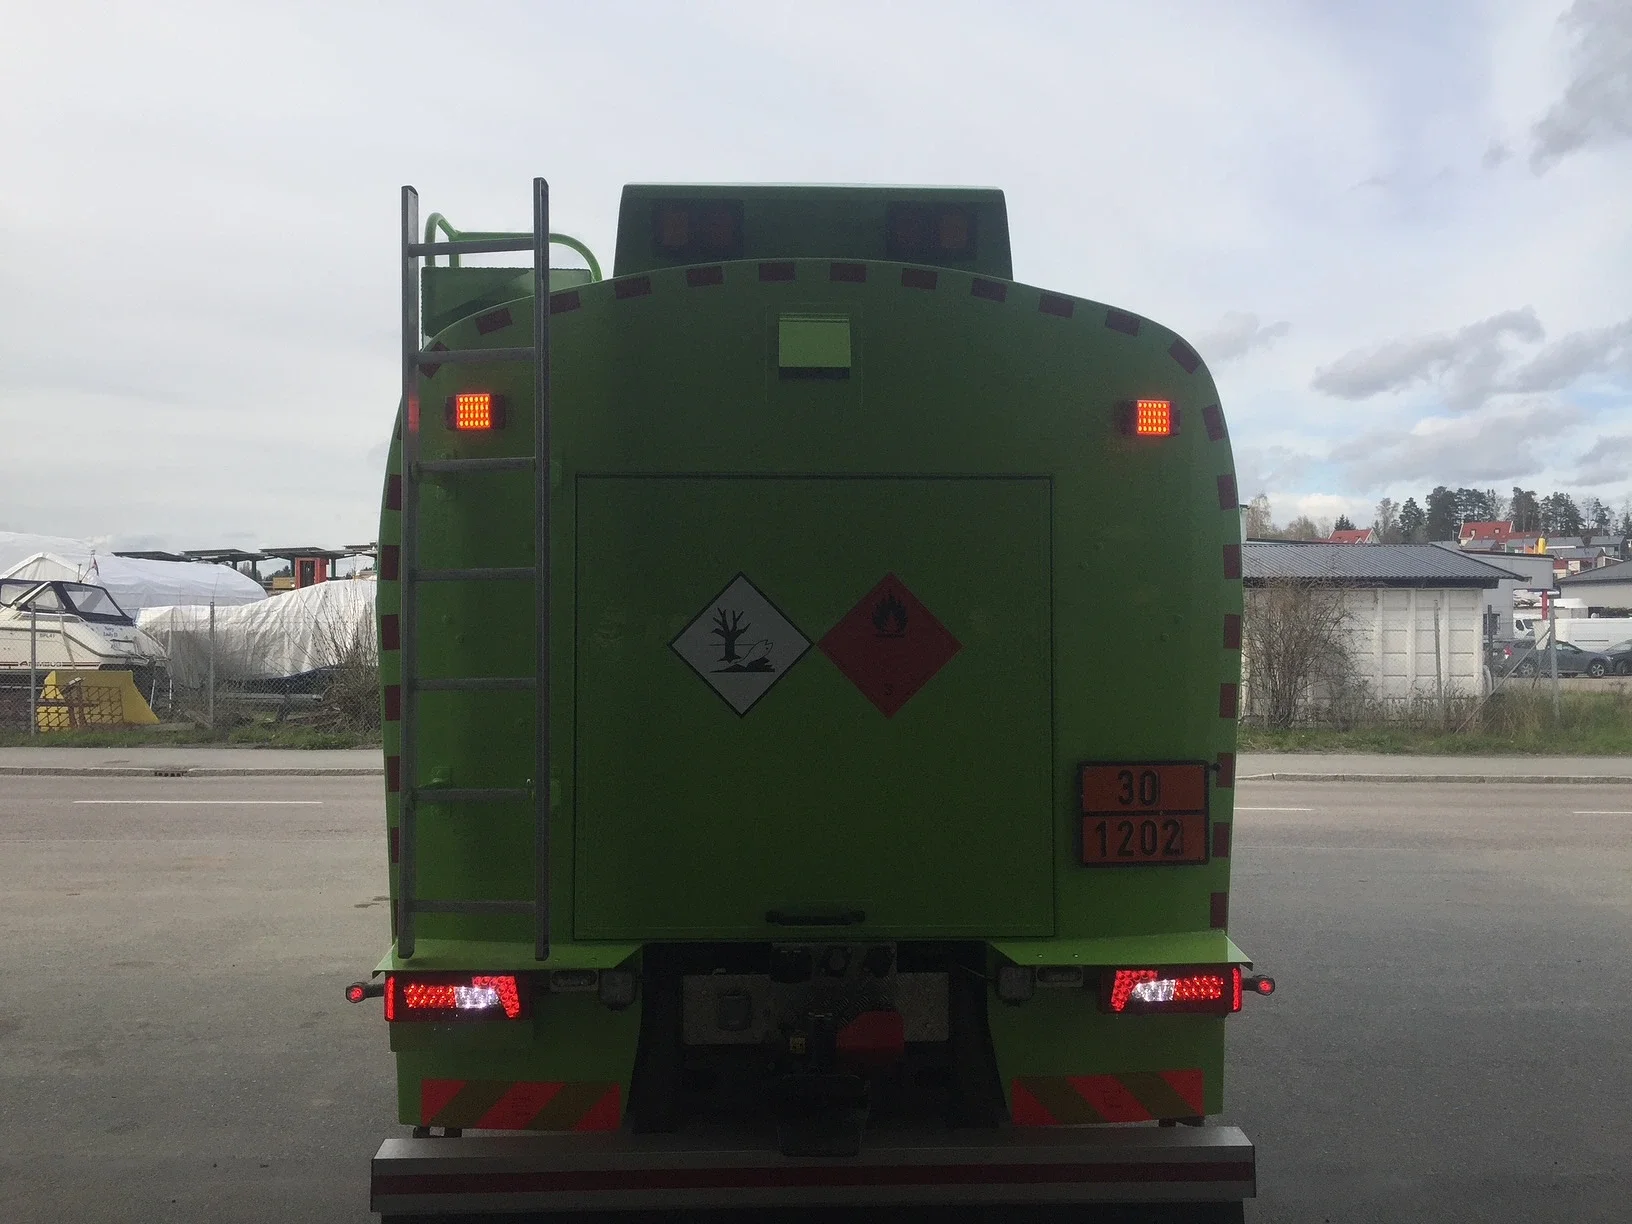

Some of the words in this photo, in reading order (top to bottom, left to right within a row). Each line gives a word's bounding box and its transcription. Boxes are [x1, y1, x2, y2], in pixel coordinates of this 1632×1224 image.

[883, 683, 893, 697] 3
[1118, 769, 1159, 806] 30
[1096, 819, 1184, 857] 1202
